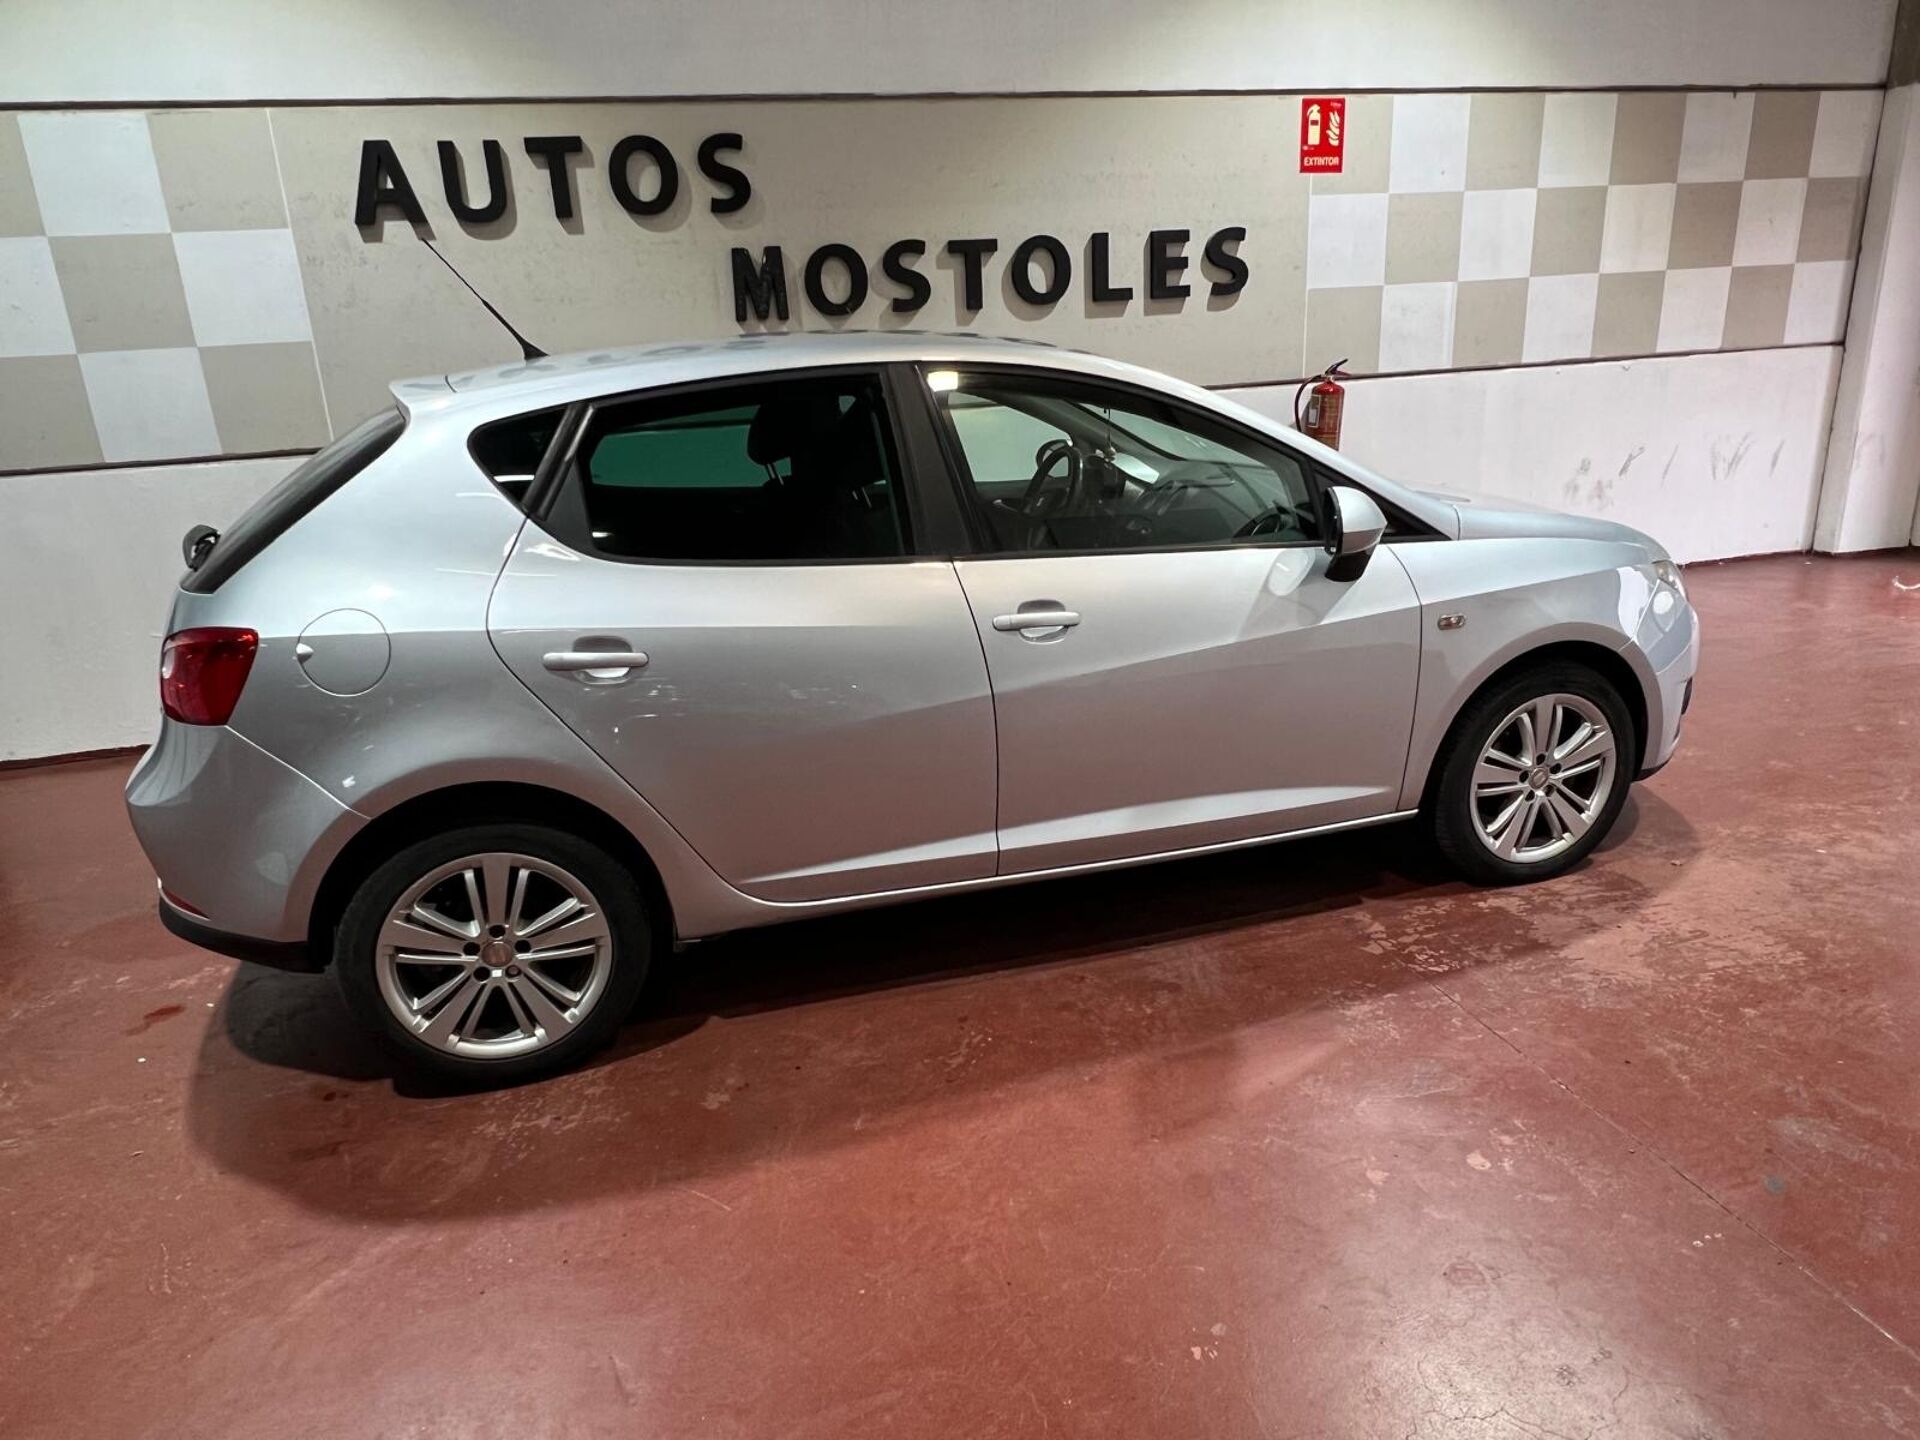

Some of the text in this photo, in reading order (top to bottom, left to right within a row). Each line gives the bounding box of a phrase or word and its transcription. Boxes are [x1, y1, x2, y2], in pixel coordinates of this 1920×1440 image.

[354, 132, 752, 227] AUTOS
[1303, 156, 1339, 166] EXTINTOR
[731, 226, 1250, 322] MOSTOLES
